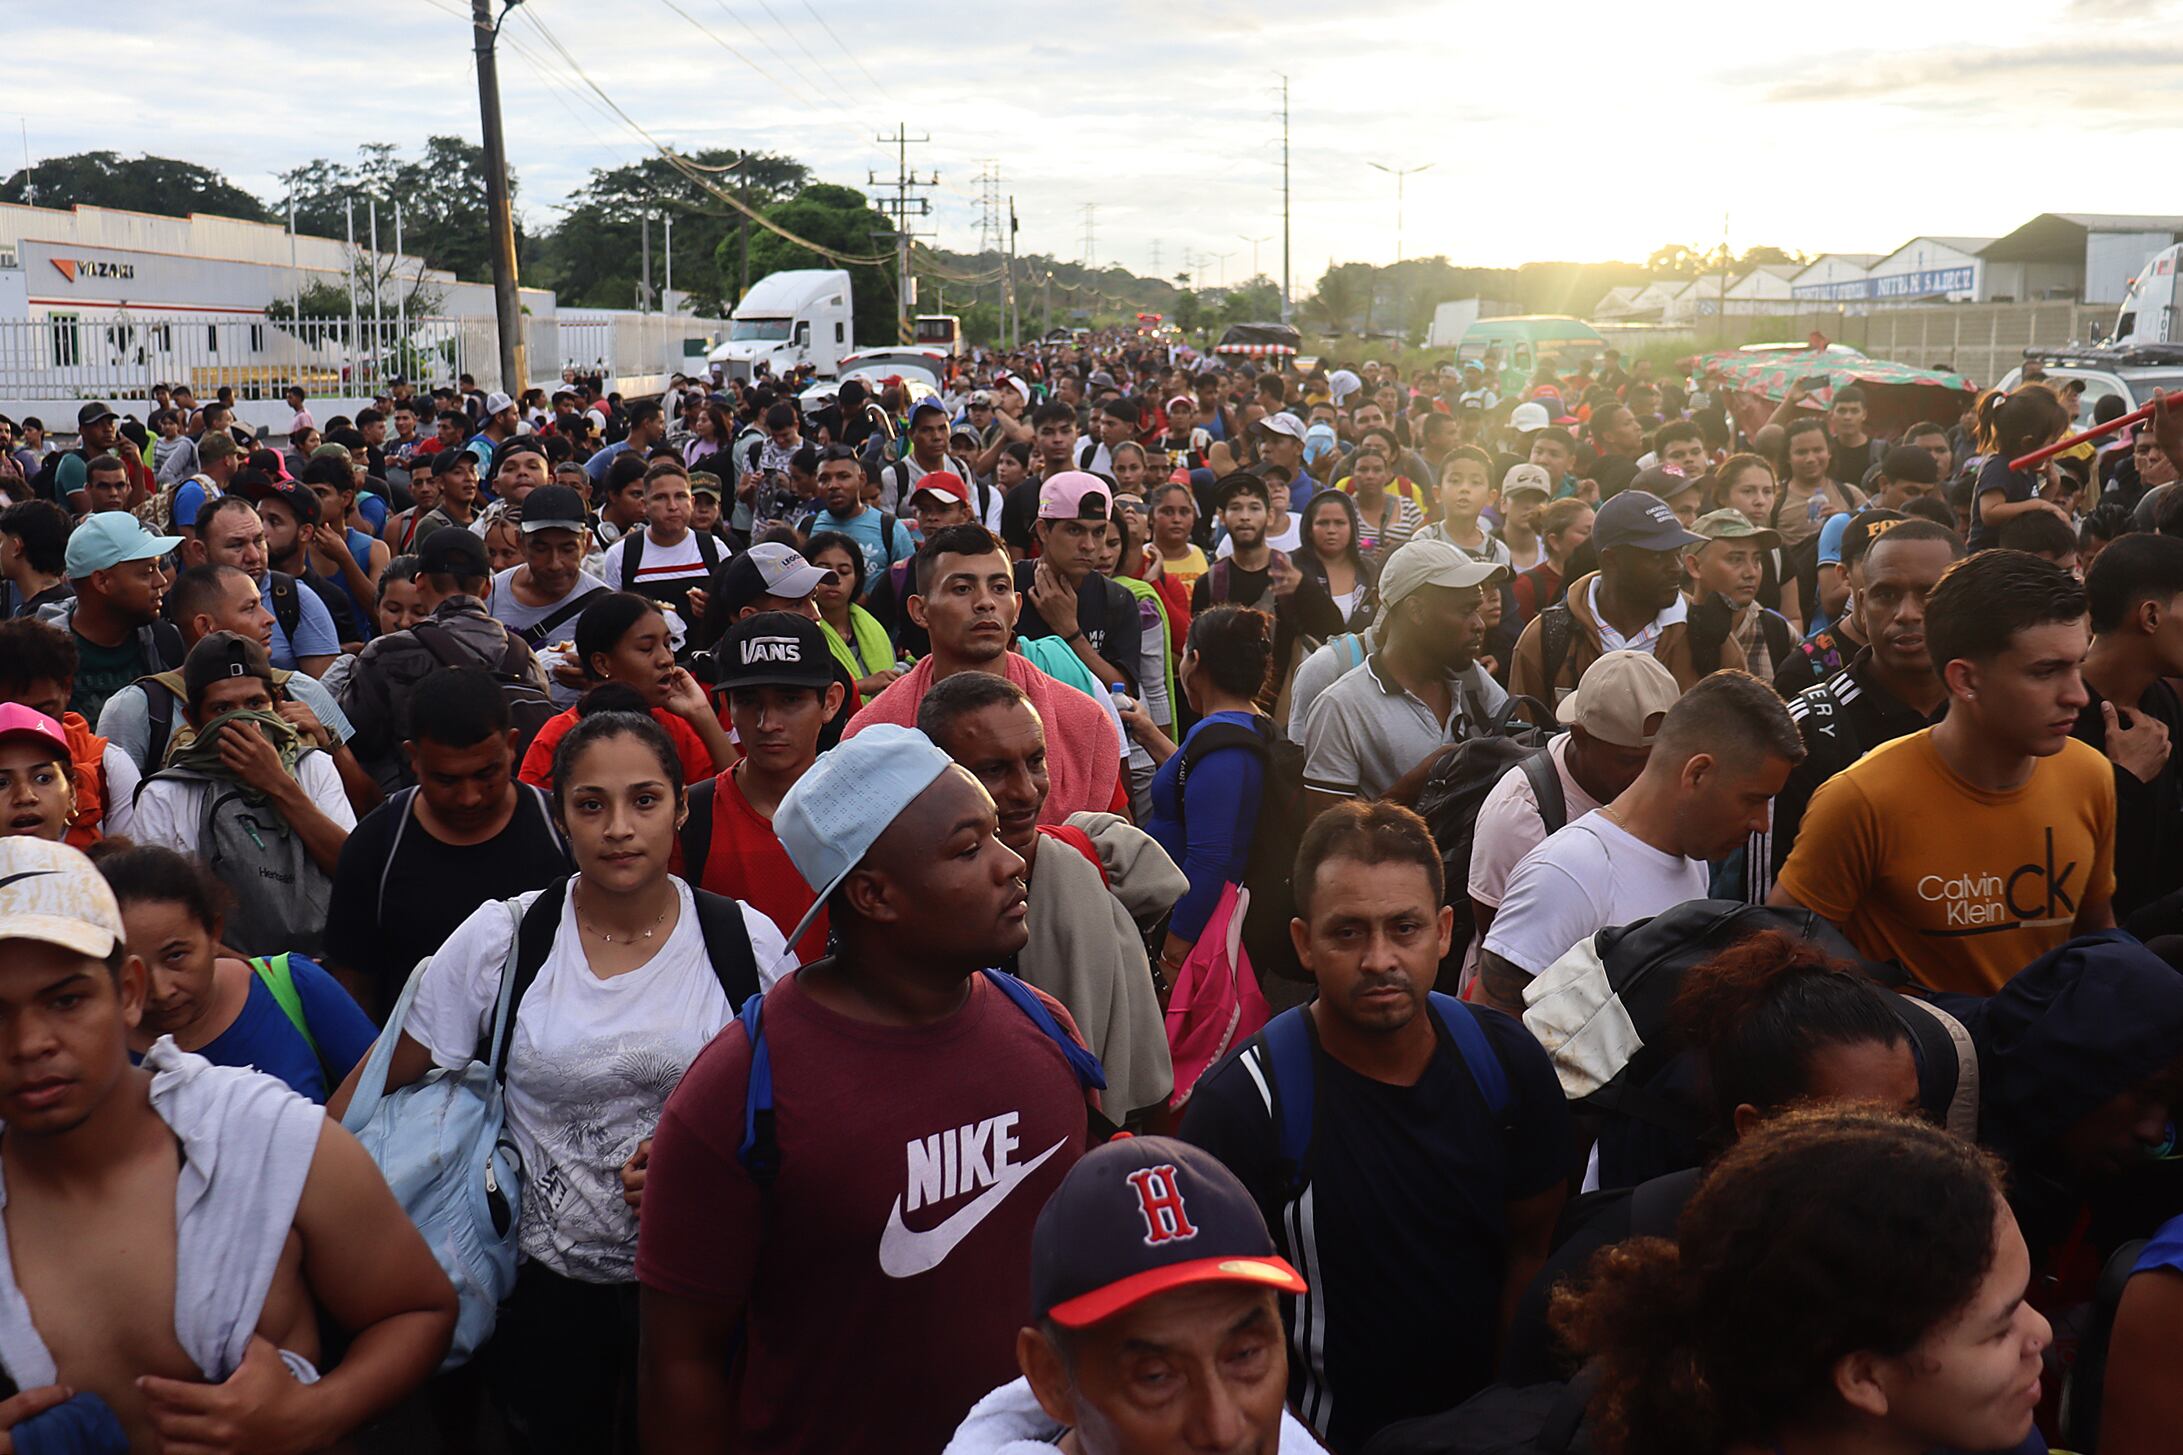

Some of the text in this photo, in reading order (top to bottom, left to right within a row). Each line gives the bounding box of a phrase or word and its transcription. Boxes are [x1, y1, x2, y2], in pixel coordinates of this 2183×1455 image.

[77, 260, 134, 279] YAZAKI
[740, 636, 801, 665] VANS
[1917, 871, 2004, 901] Calvin
[1946, 898, 2005, 926] Klein
[906, 1110, 1022, 1213] NIKE
[1126, 1164, 1199, 1245] H
